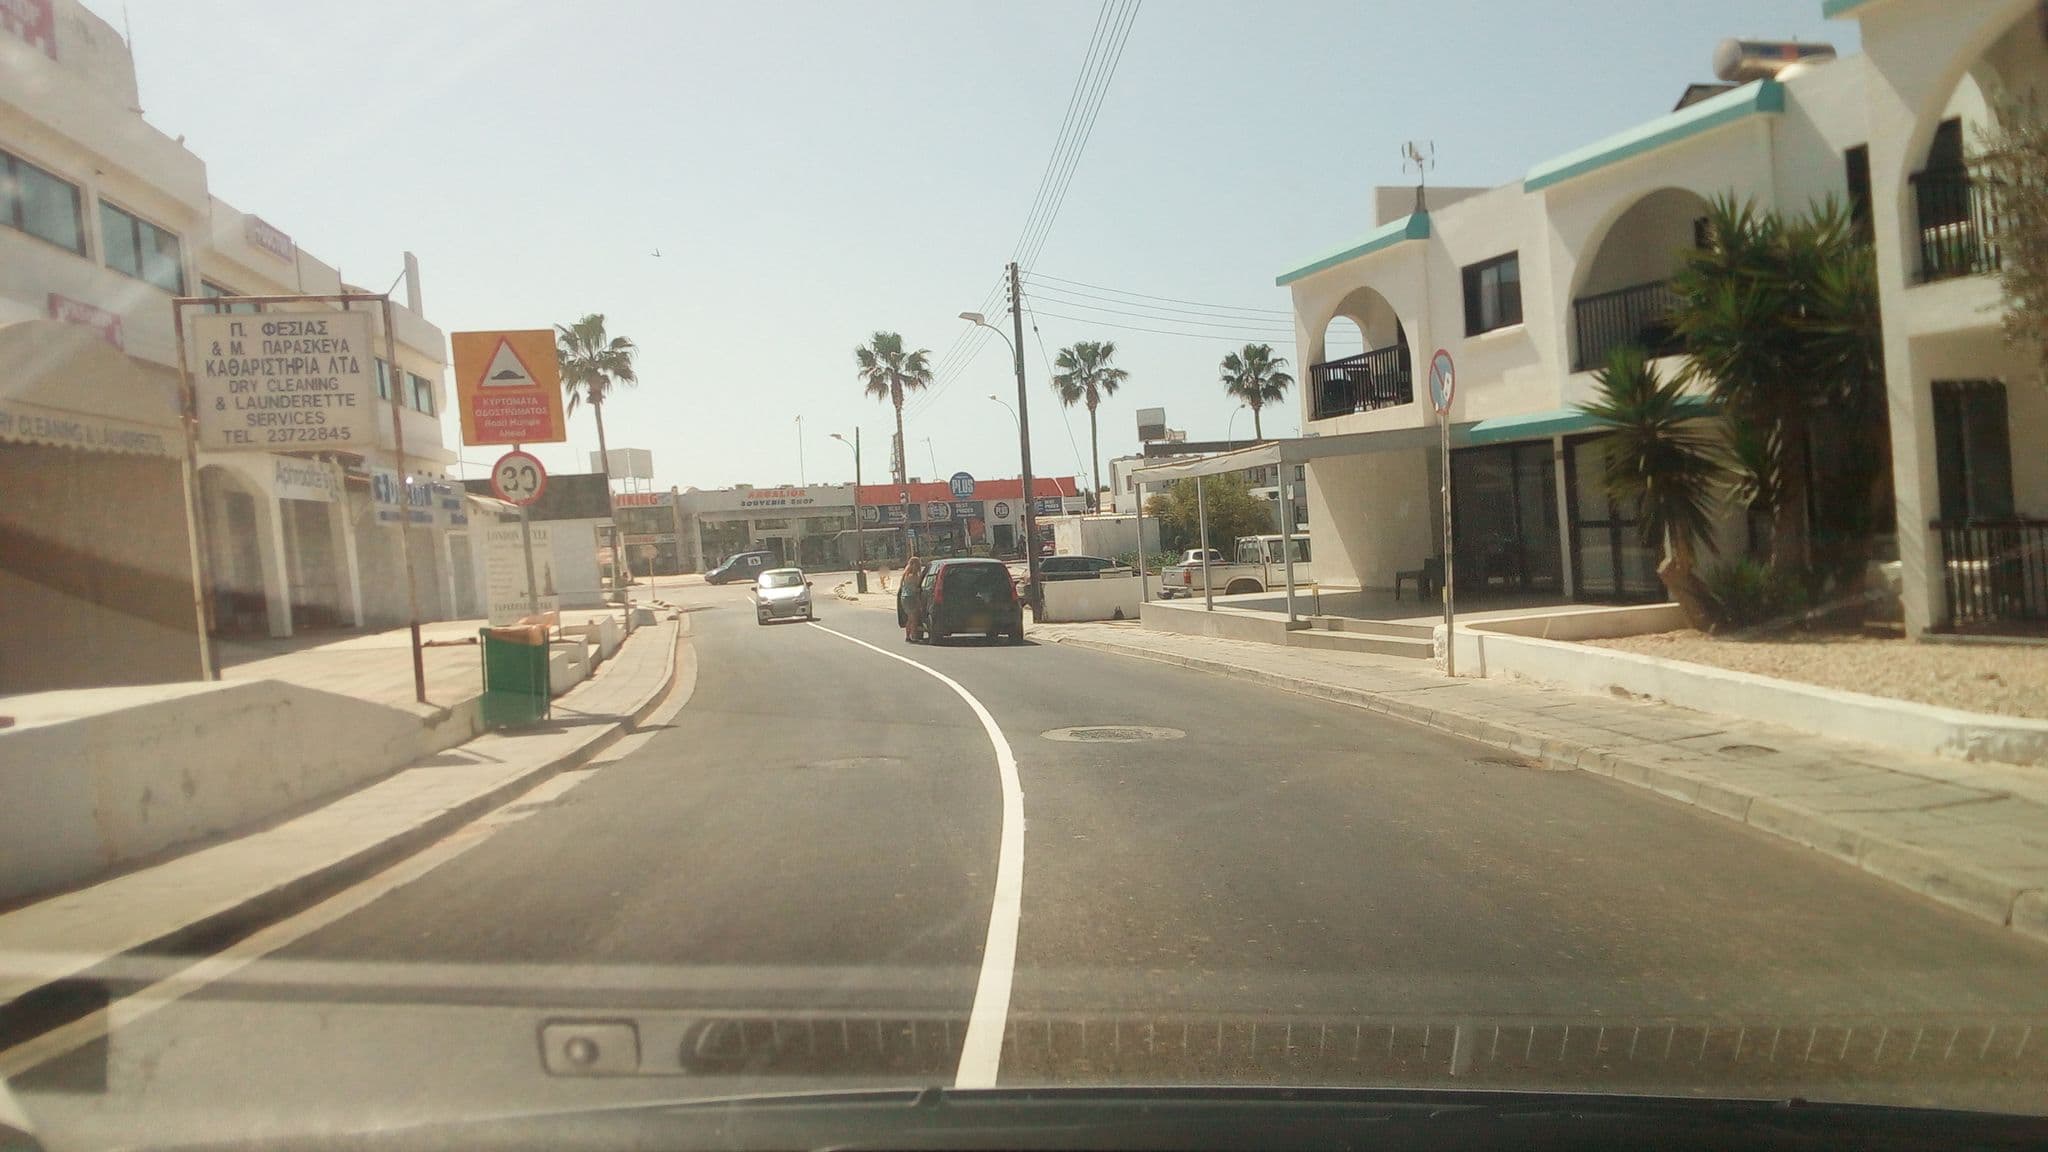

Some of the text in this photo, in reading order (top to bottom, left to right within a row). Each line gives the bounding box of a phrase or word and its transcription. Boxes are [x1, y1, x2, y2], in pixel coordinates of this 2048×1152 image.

[262, 320, 328, 337] ΦΕΣΙΑΣ
[211, 341, 222, 356] &
[263, 338, 350, 355] ΠΑΡΑΣΚΕΥΑ
[205, 356, 361, 377] ΚΑΘΑΡΙΣΤΗΡΙΑ ΛΤΔ
[229, 377, 339, 393] DRY CLEANING
[215, 393, 356, 410] & LAUNDERETTE
[246, 411, 326, 427] SERVICES
[267, 427, 351, 443] 23722845
[502, 465, 537, 493] 30
[952, 479, 973, 494] PLUS
[741, 499, 786, 507] SOUVENIR
